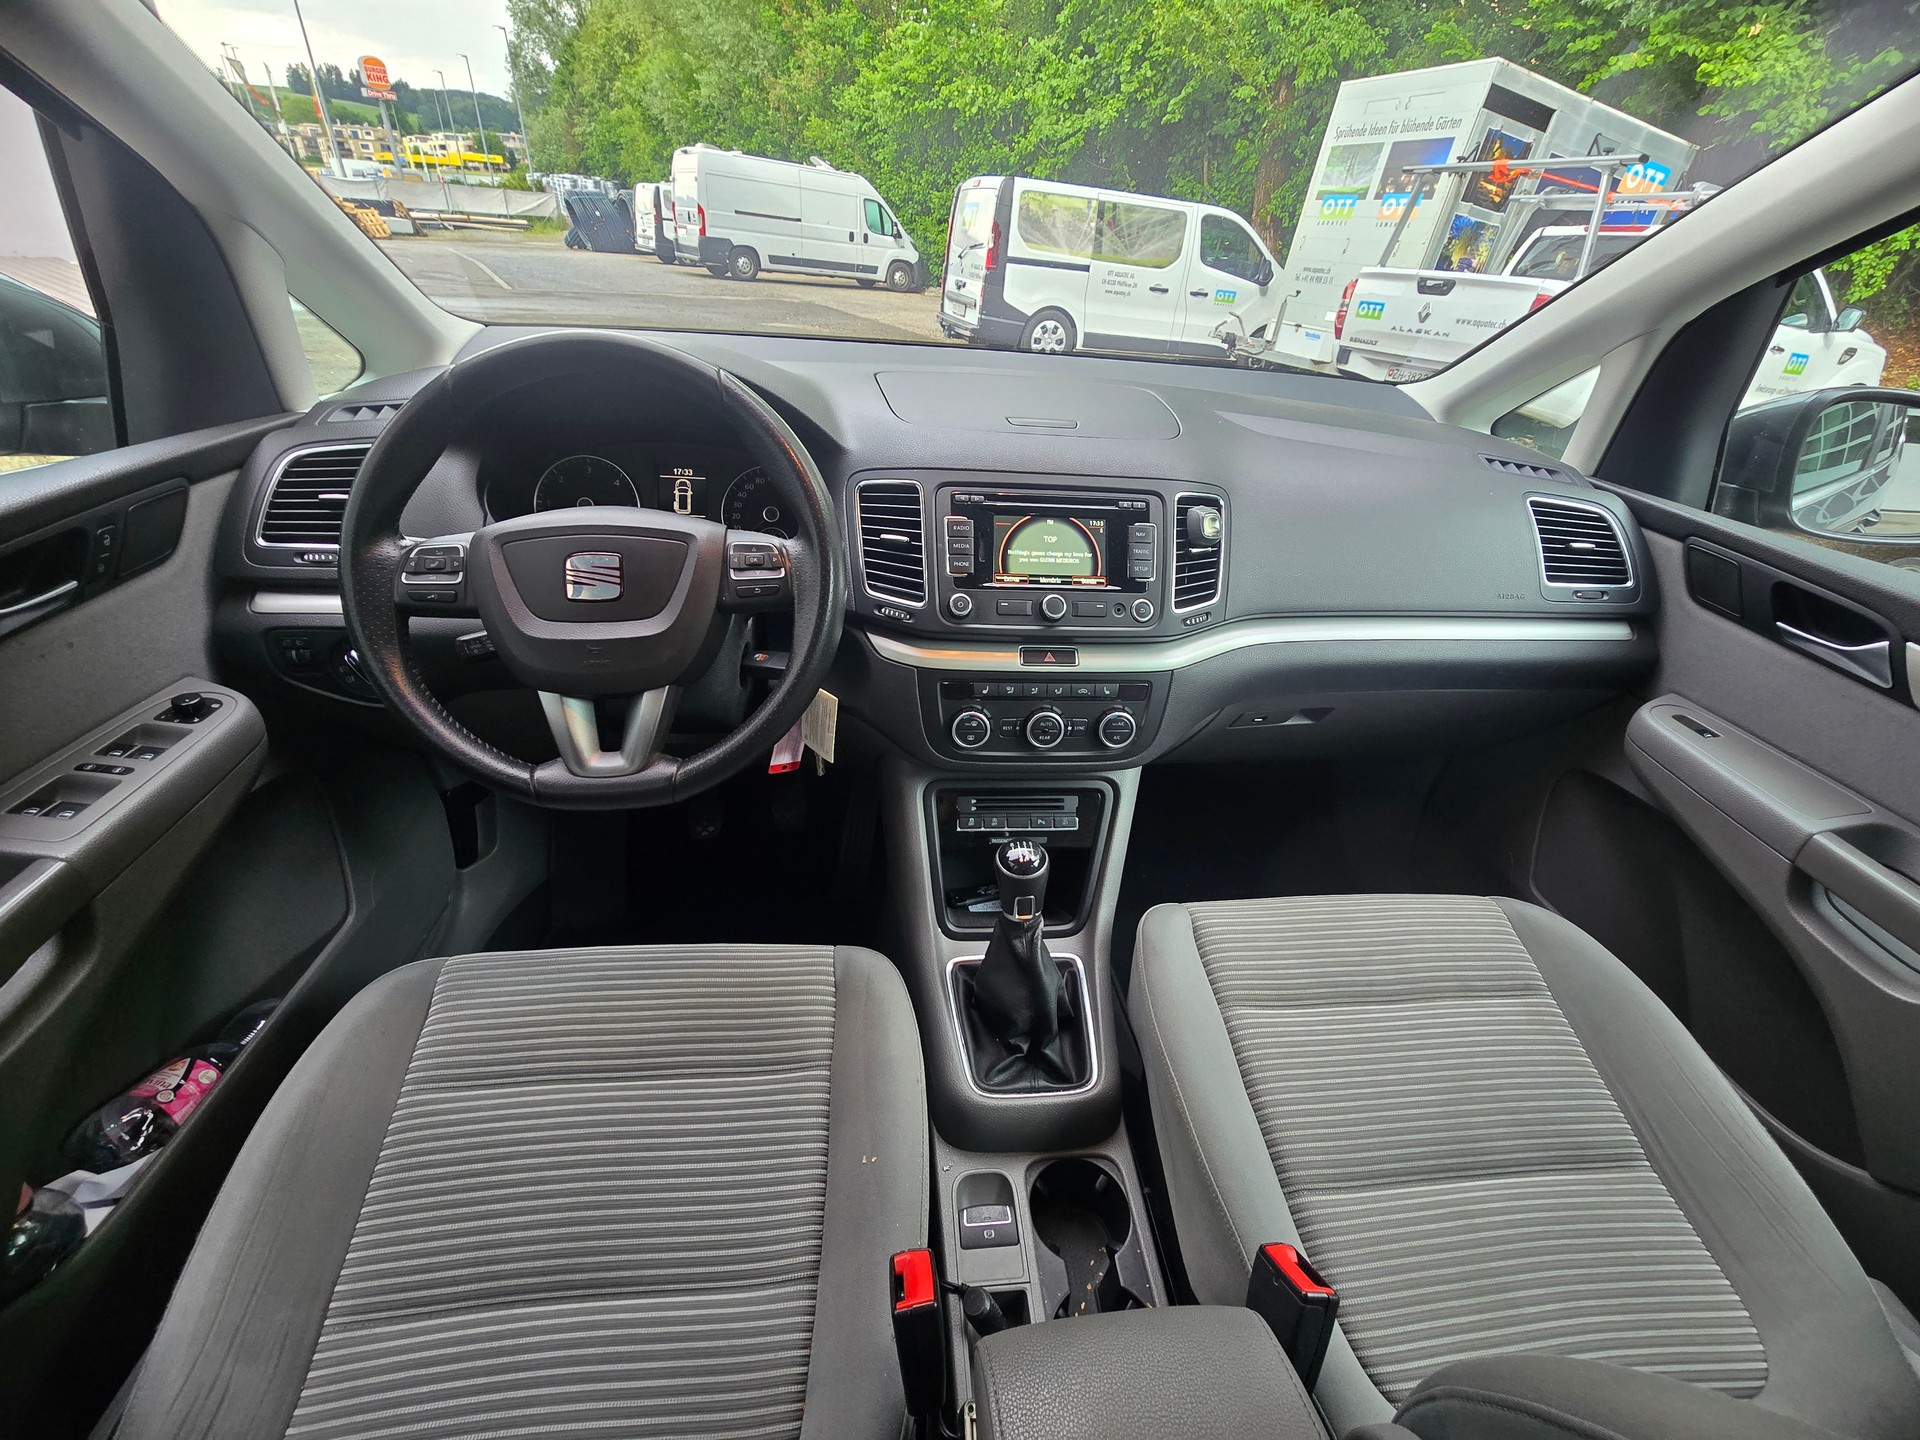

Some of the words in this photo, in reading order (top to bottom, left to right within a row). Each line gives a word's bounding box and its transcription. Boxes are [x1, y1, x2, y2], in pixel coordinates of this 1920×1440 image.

[364, 66, 387, 74] BURGER
[366, 72, 389, 84] KING
[1334, 123, 1367, 140] Sprühende
[1368, 122, 1388, 136] Ideen
[1388, 120, 1400, 136] für
[1400, 116, 1434, 134] blühende
[1435, 116, 1463, 131] Gärten
[1626, 163, 1665, 194] OTT
[1322, 198, 1353, 216] OTT
[1217, 292, 1234, 301] OTT
[1358, 303, 1382, 318] OTT
[1390, 325, 1451, 338] ALASKAN
[1349, 336, 1378, 346] RENAULT
[1786, 355, 1806, 372] OTT
[673, 468, 693, 476] 17:33
